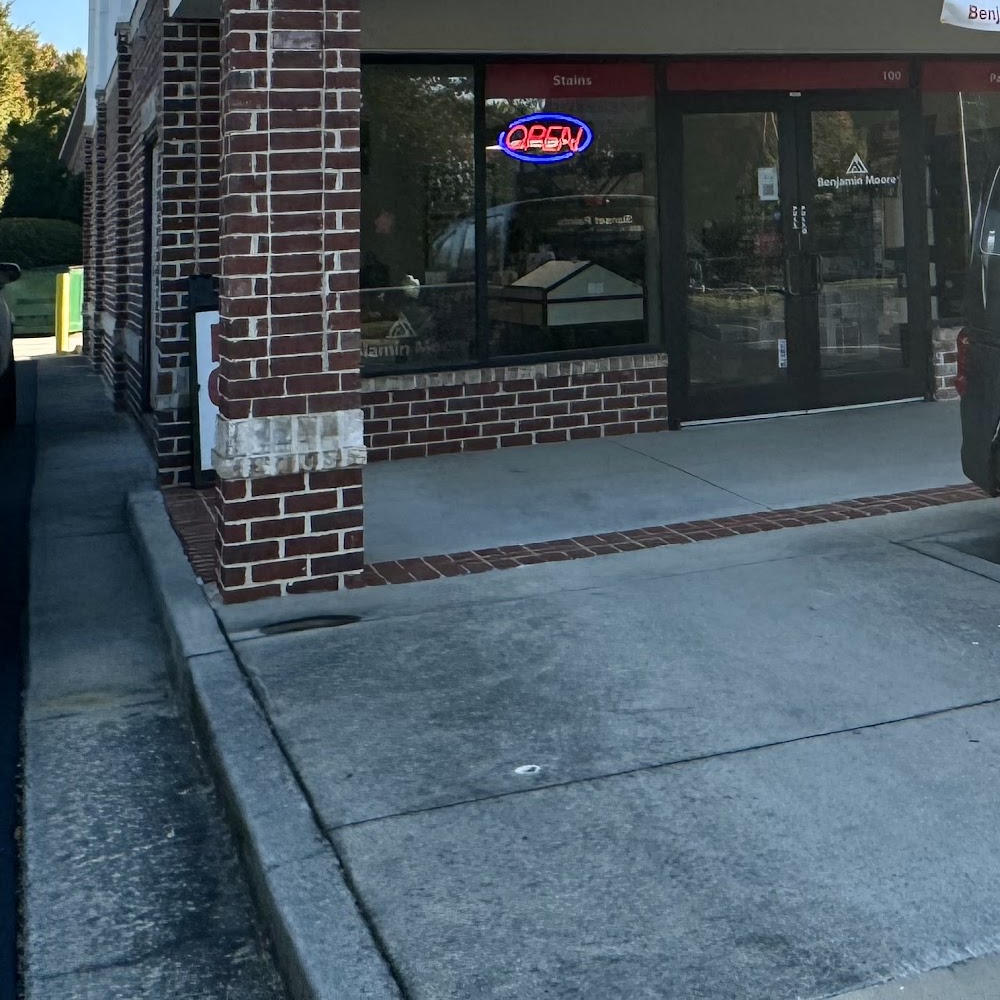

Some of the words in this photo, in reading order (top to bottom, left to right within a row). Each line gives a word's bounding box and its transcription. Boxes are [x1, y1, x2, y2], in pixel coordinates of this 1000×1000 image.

[552, 75, 592, 87] Stains
[882, 70, 901, 80] 100
[505, 124, 584, 152] OPEN
[817, 175, 863, 188] Benjamin
[865, 175, 896, 185] Moore
